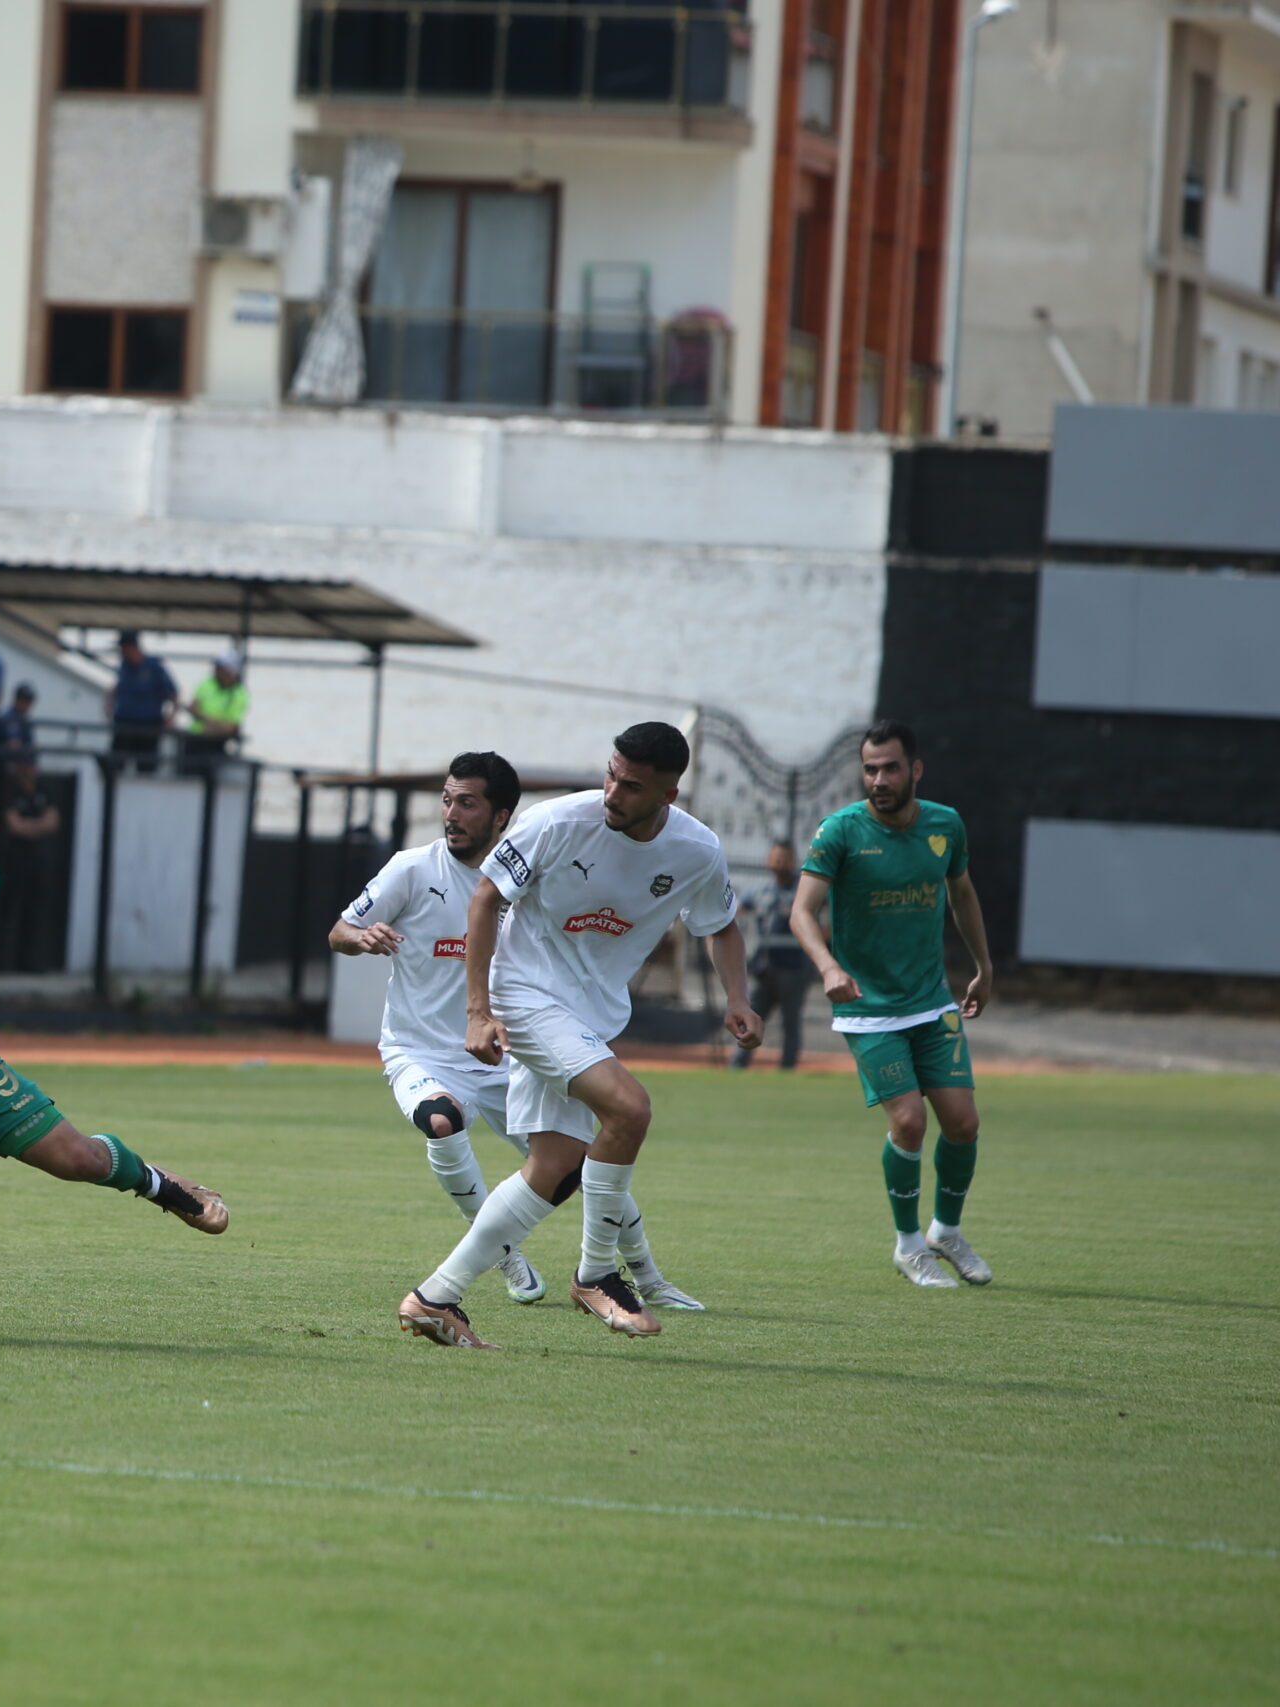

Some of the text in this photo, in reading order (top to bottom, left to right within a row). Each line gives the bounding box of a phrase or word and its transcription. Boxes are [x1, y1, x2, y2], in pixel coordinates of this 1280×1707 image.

[499, 841, 529, 882] NAZBEL
[568, 916, 630, 935] MURATBEY
[437, 943, 467, 954] MUR
[944, 1032, 964, 1064] 7
